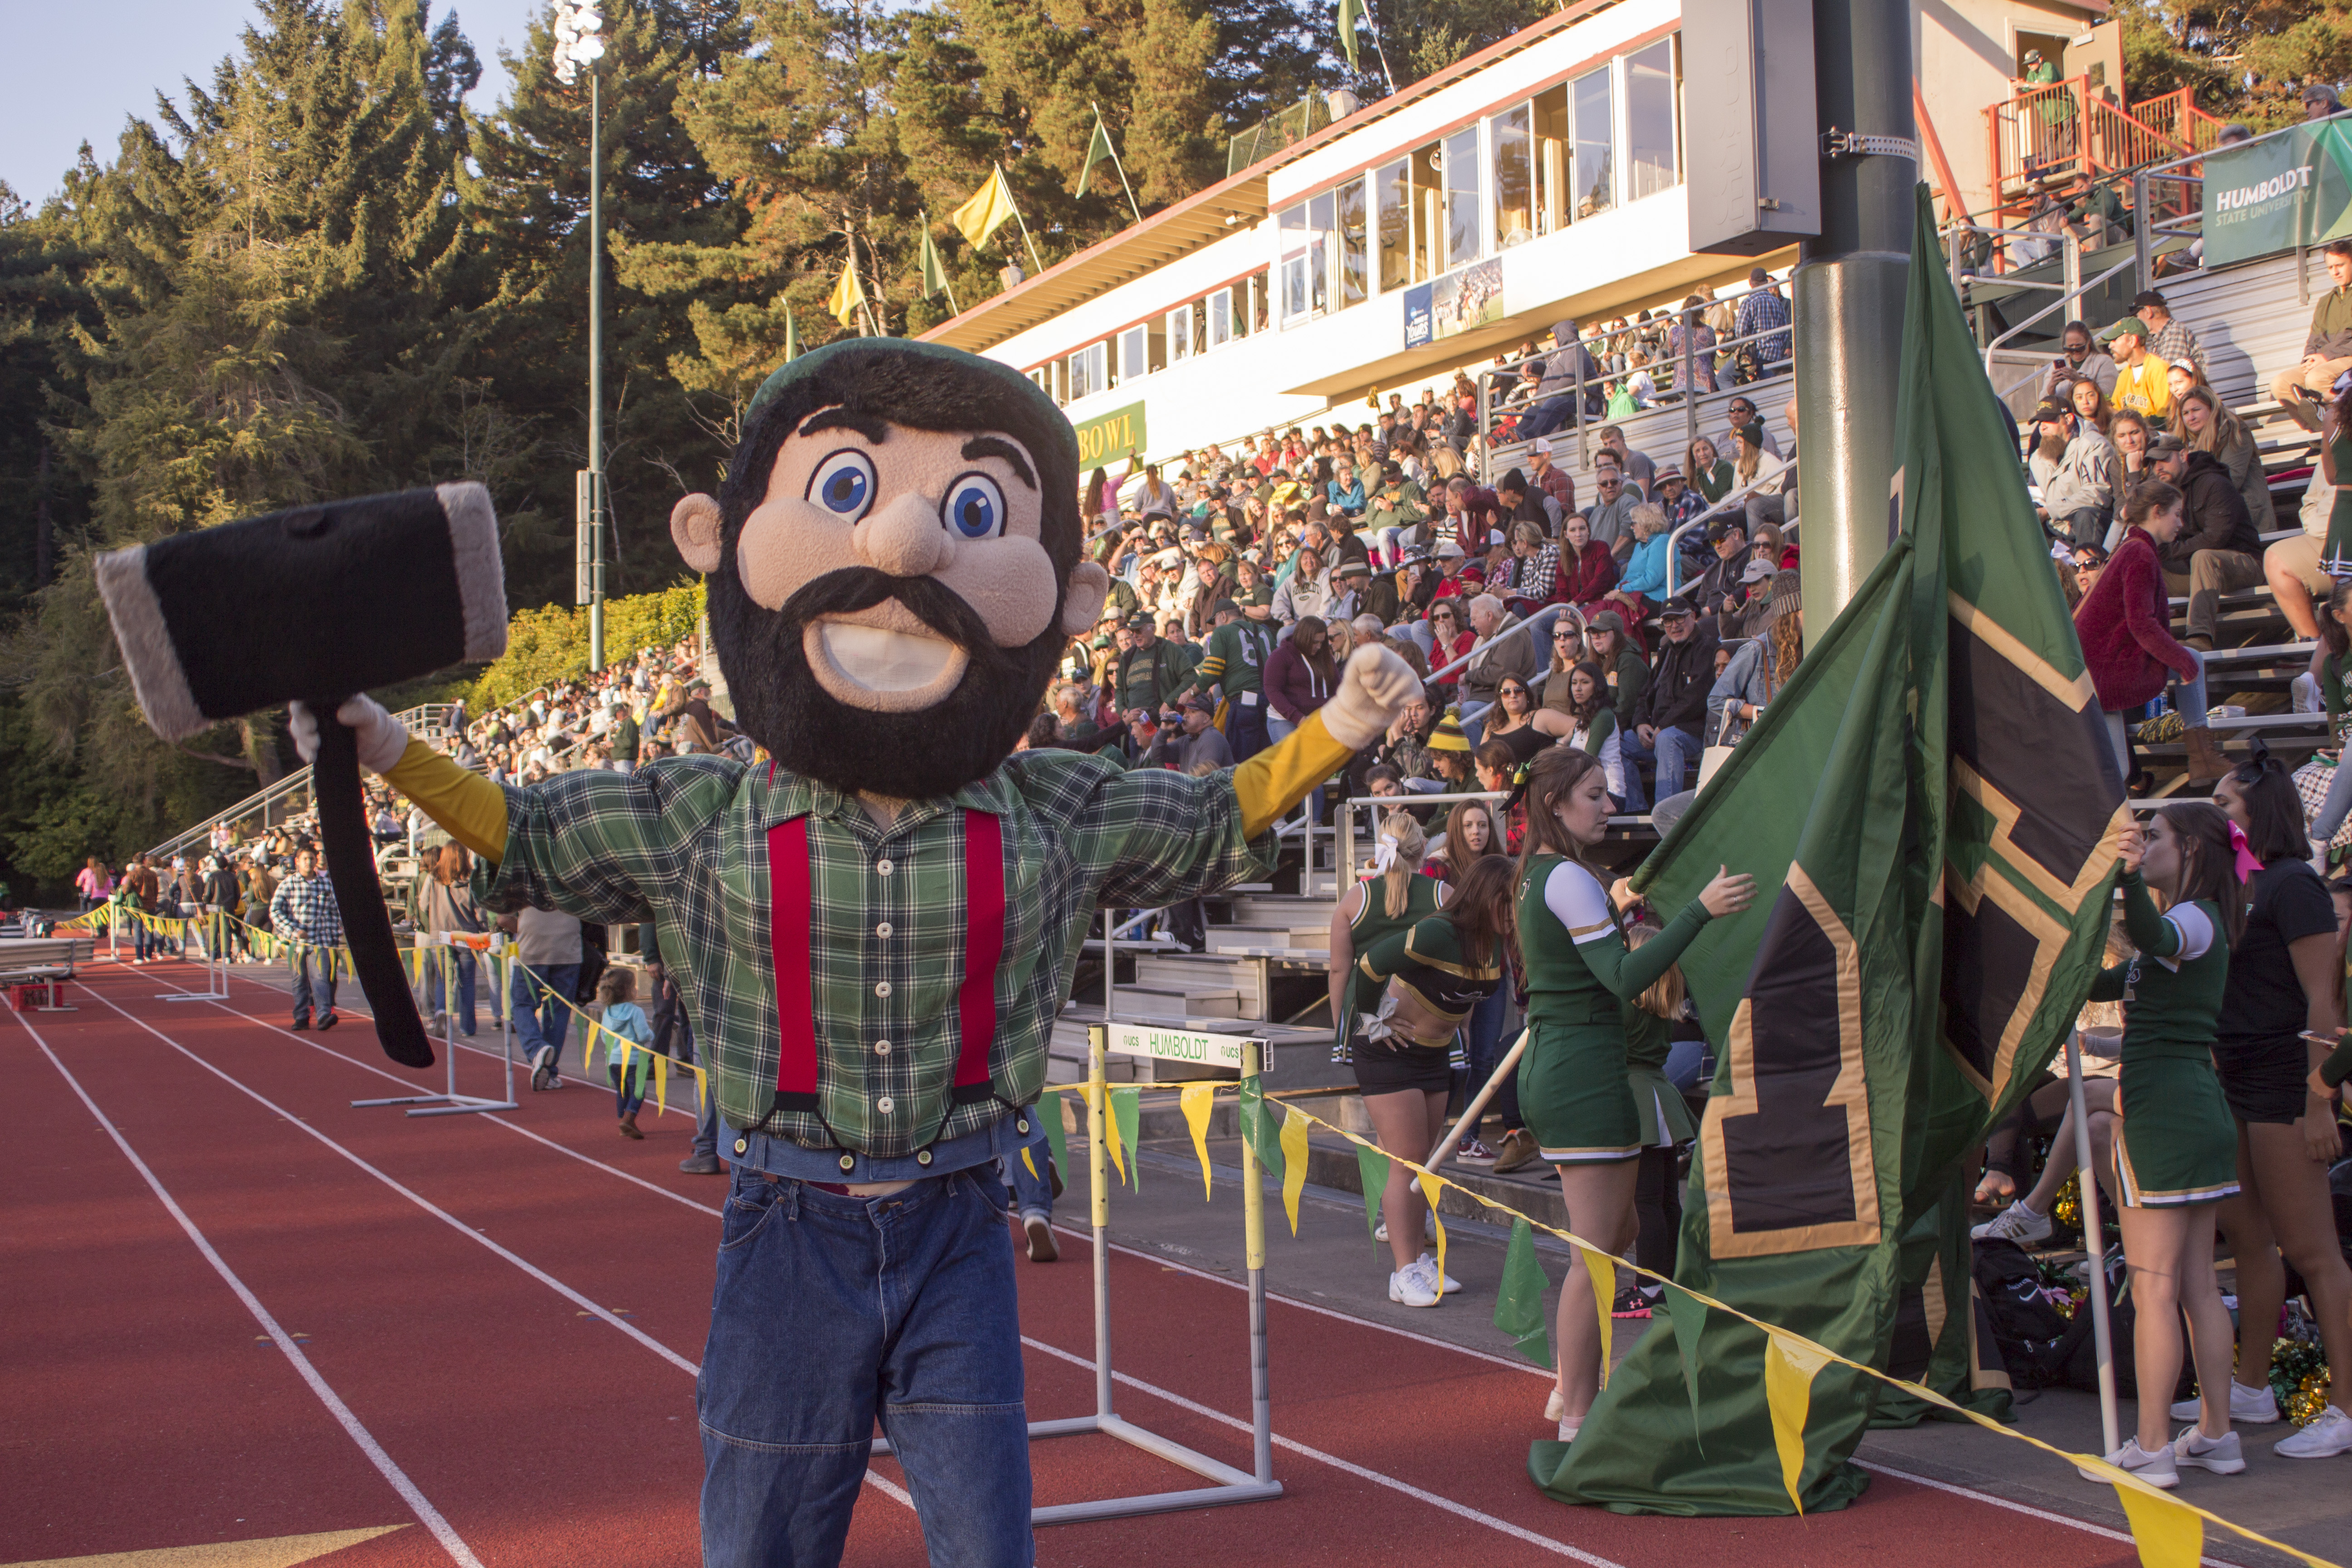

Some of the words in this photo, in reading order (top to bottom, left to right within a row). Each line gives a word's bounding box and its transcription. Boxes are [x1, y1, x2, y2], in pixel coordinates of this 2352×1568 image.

[2216, 166, 2313, 212] HUMBOLDT
[2216, 209, 2247, 226] STATE
[2250, 190, 2311, 219] UNIVERSITY
[1078, 414, 1135, 462] BOWL
[1128, 1036, 1139, 1047] UCS
[1150, 1033, 1208, 1060] HUMBOLDT
[1226, 1046, 1239, 1058] UCS
